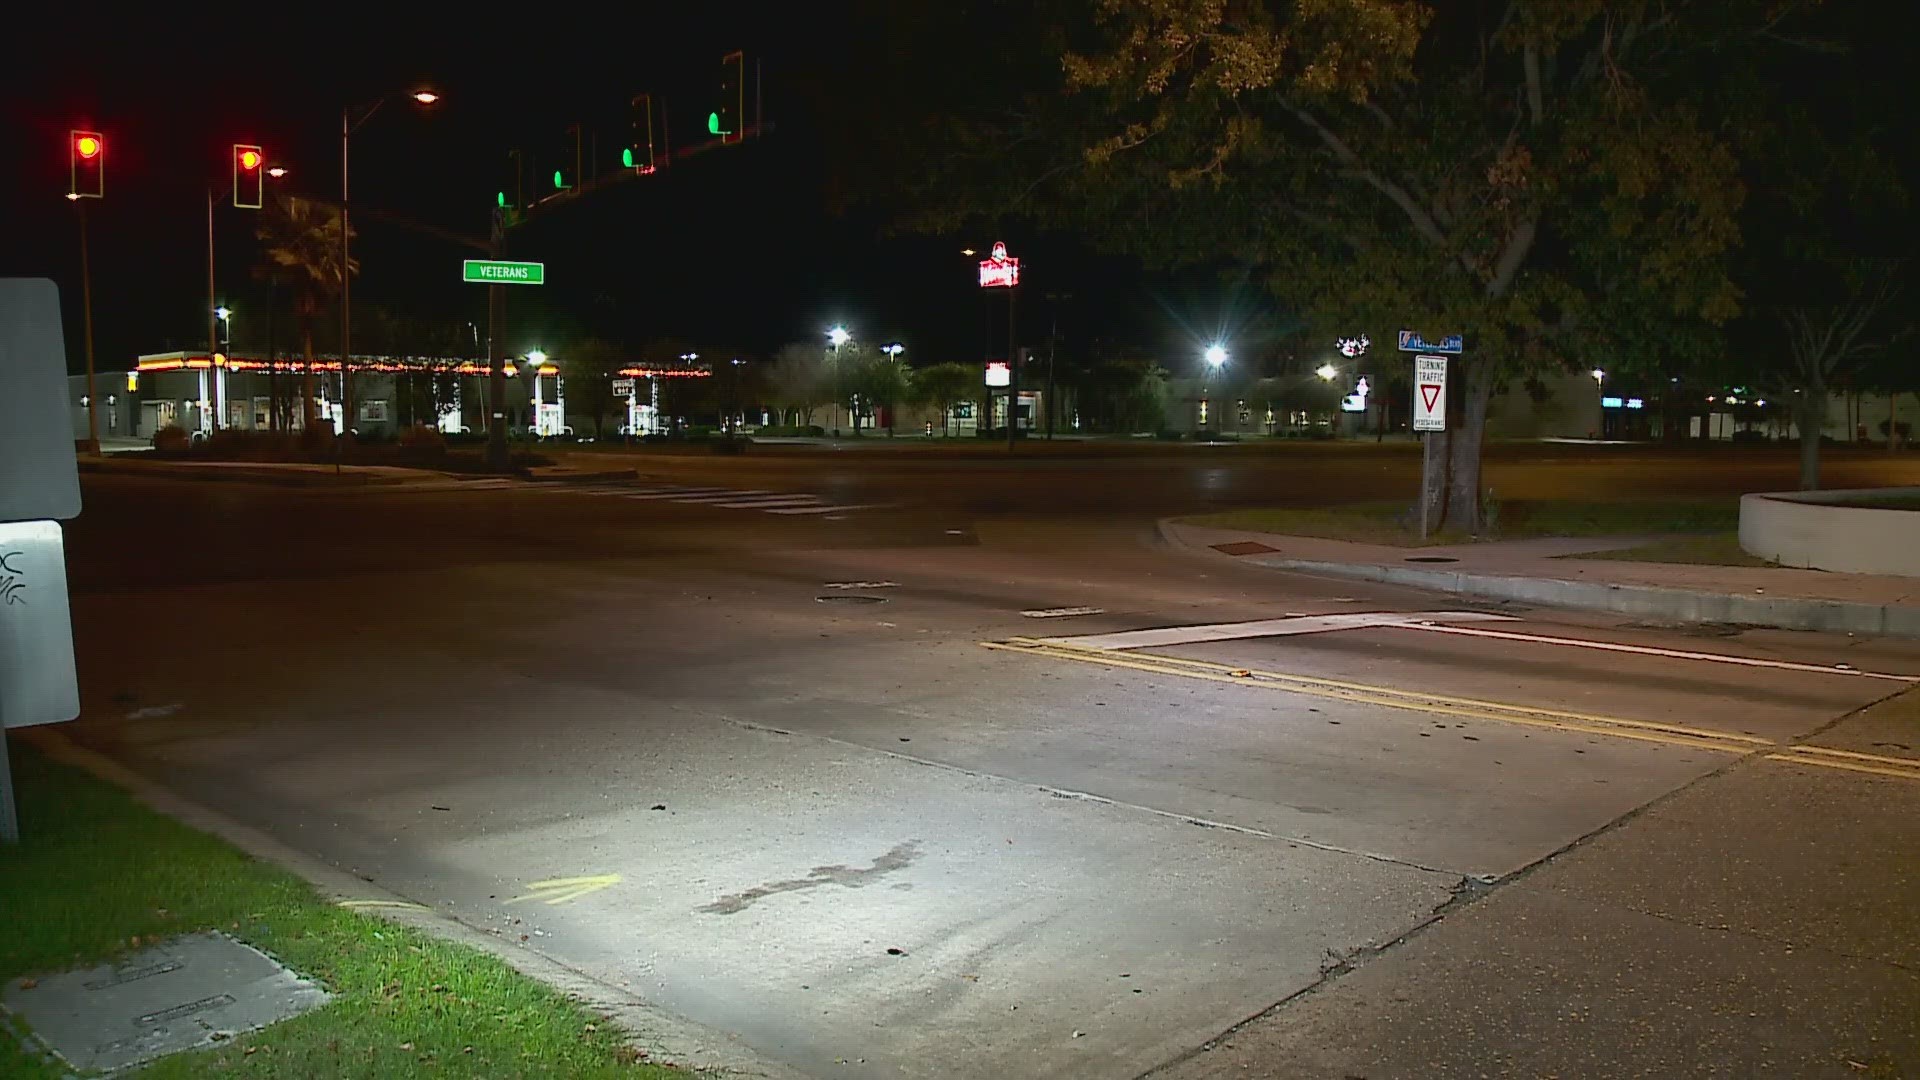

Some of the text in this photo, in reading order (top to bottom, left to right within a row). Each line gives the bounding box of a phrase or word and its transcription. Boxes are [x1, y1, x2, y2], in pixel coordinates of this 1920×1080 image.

[480, 265, 528, 279] VETERANS
[1413, 335, 1449, 349] VETENS
[1419, 360, 1444, 371] TURNING
[1419, 372, 1443, 383] TRAFFIC
